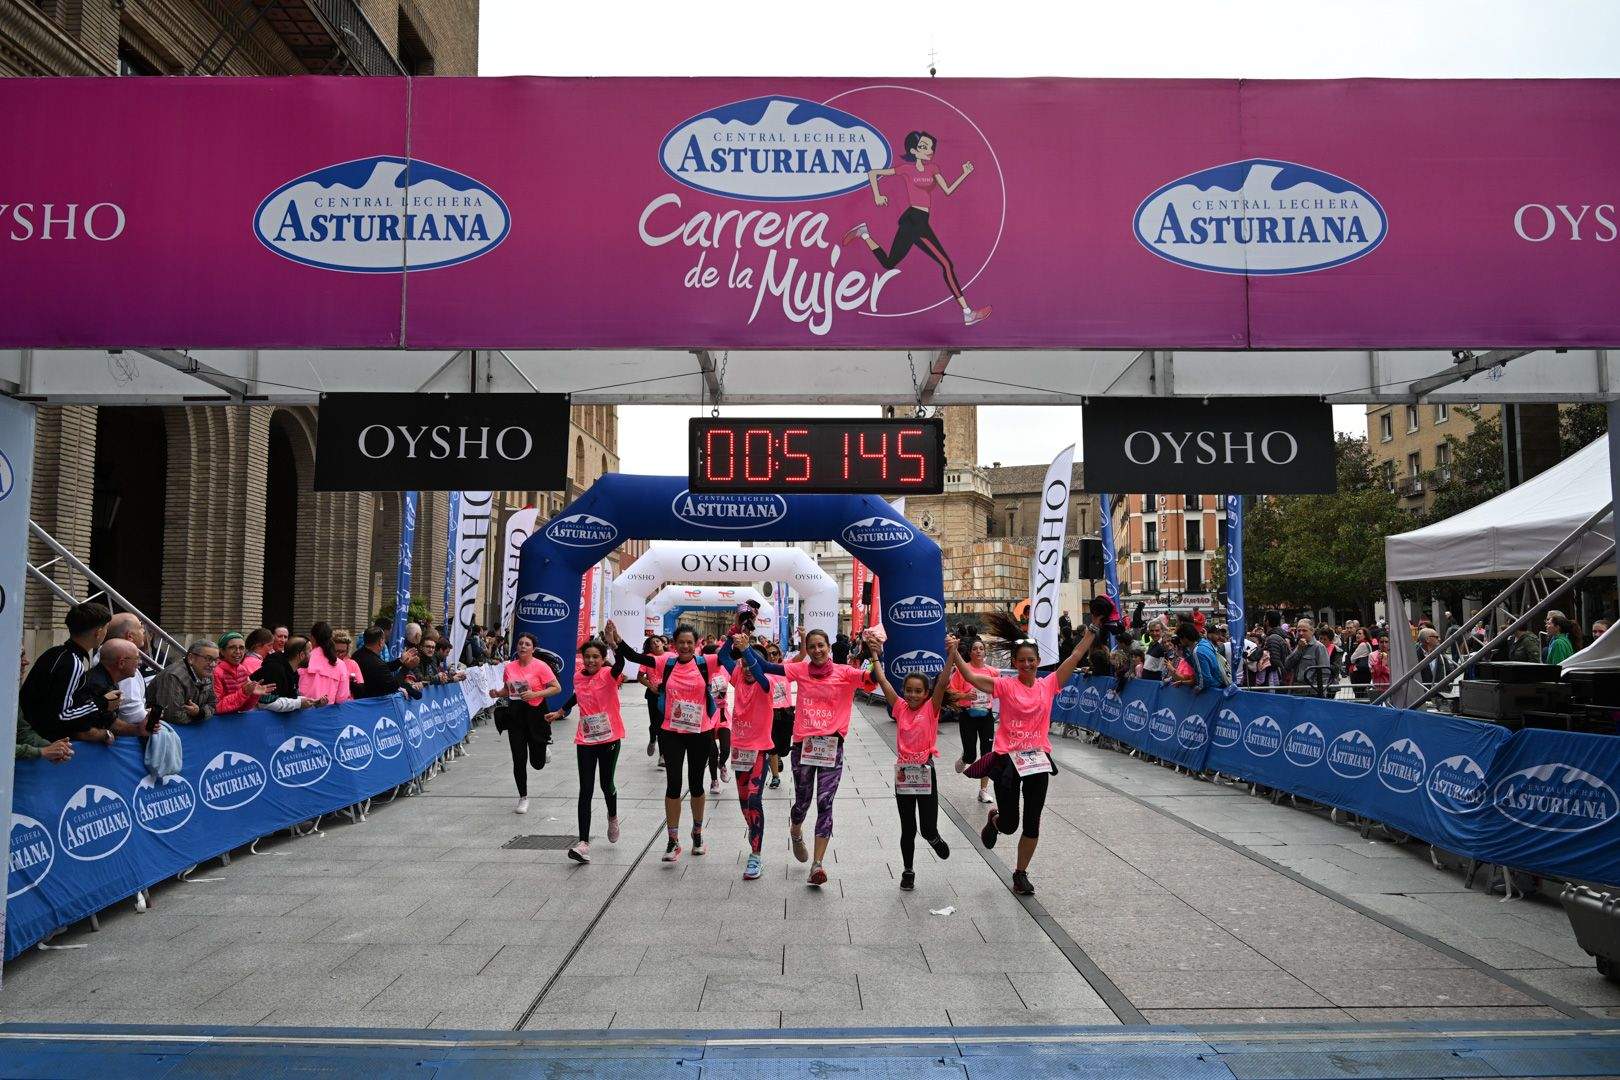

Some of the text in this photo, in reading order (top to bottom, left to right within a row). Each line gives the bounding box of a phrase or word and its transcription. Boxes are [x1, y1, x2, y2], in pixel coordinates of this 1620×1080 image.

[713, 132, 867, 143] CENTRAL LECHERA
[677, 134, 872, 175] ASTURIANA
[314, 196, 483, 208] CENTRAL LECHERA
[1192, 198, 1360, 210] CENTRAL LECHERA
[0, 203, 126, 241] SHO
[273, 199, 491, 242] ASTURIANA
[639, 193, 830, 249] Carrera
[1154, 202, 1369, 245] ASTURIANA
[684, 244, 901, 335] de la Mujer
[358, 424, 533, 461] OYSHO
[1124, 430, 1298, 465] OYSHO
[681, 496, 778, 518] ASTURIANA
[550, 525, 612, 540] ASTURIANA
[848, 529, 909, 542] ASTURIANA
[681, 554, 770, 572] OYSHO
[1034, 479, 1068, 629] OYSHO
[518, 605, 565, 617] ASTURIANA
[892, 608, 941, 619] ASTURIANA
[1245, 728, 1279, 748] ASTURIANA
[1286, 735, 1321, 758] ASTURIANA
[340, 743, 372, 762] ASTURIANA
[1329, 744, 1371, 769] ASTURIANA
[276, 754, 329, 779] ASTURIANA
[205, 771, 263, 801] ASTURIANA
[138, 793, 193, 822] ASTURIANA
[1500, 784, 1608, 820] ASTURIANA
[66, 811, 130, 850] ASTURIANA
